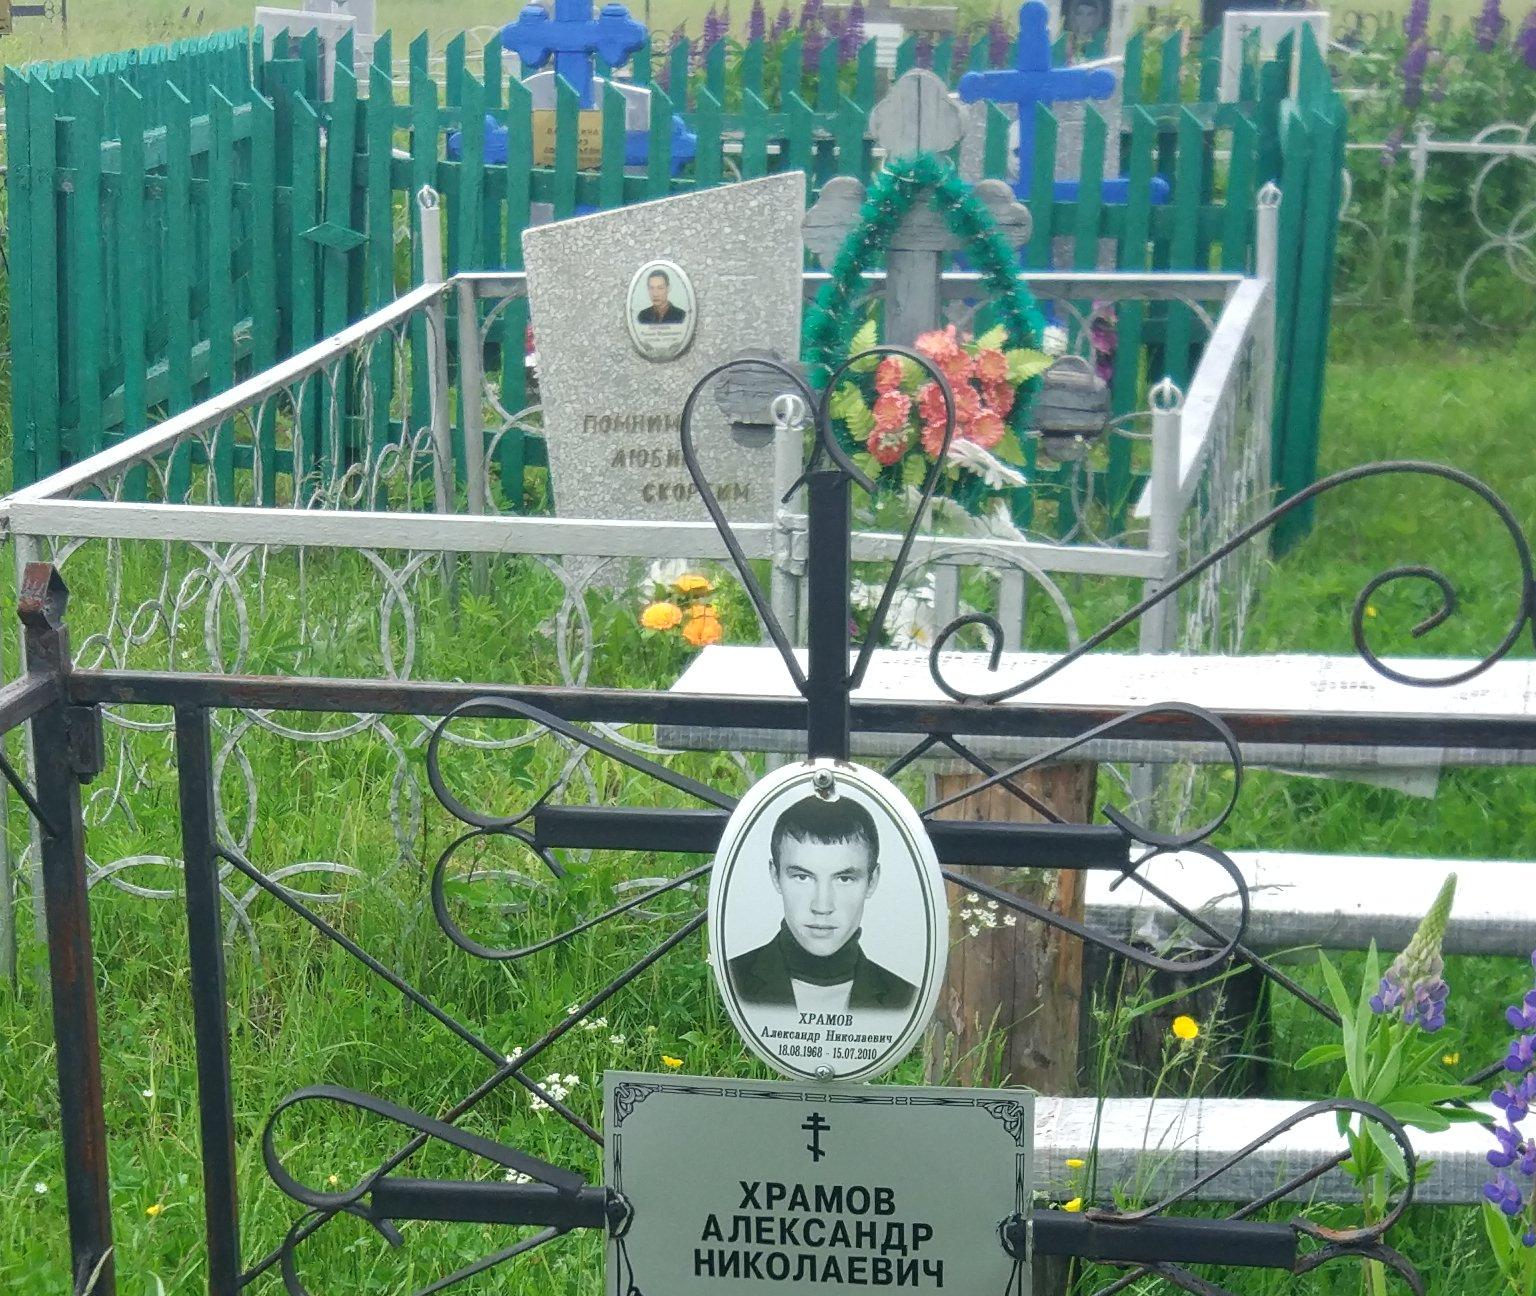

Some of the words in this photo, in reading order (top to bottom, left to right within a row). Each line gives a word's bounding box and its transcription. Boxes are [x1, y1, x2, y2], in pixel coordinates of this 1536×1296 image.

[611, 448, 696, 468] ЛЮБИ
[641, 482, 751, 504] СКОРИМ
[798, 1012, 854, 1027] ХРАМОВ
[760, 1025, 821, 1043] Александр
[825, 1029, 893, 1044] Николаевич
[778, 1044, 823, 1058] 18.08.1968
[832, 1046, 878, 1060] 15.07.2010
[738, 1180, 897, 1216] ХРАМОВ
[700, 1213, 934, 1257] АЛЕКСАНДР
[693, 1248, 945, 1288] НИКОЛАЕВИЧ
